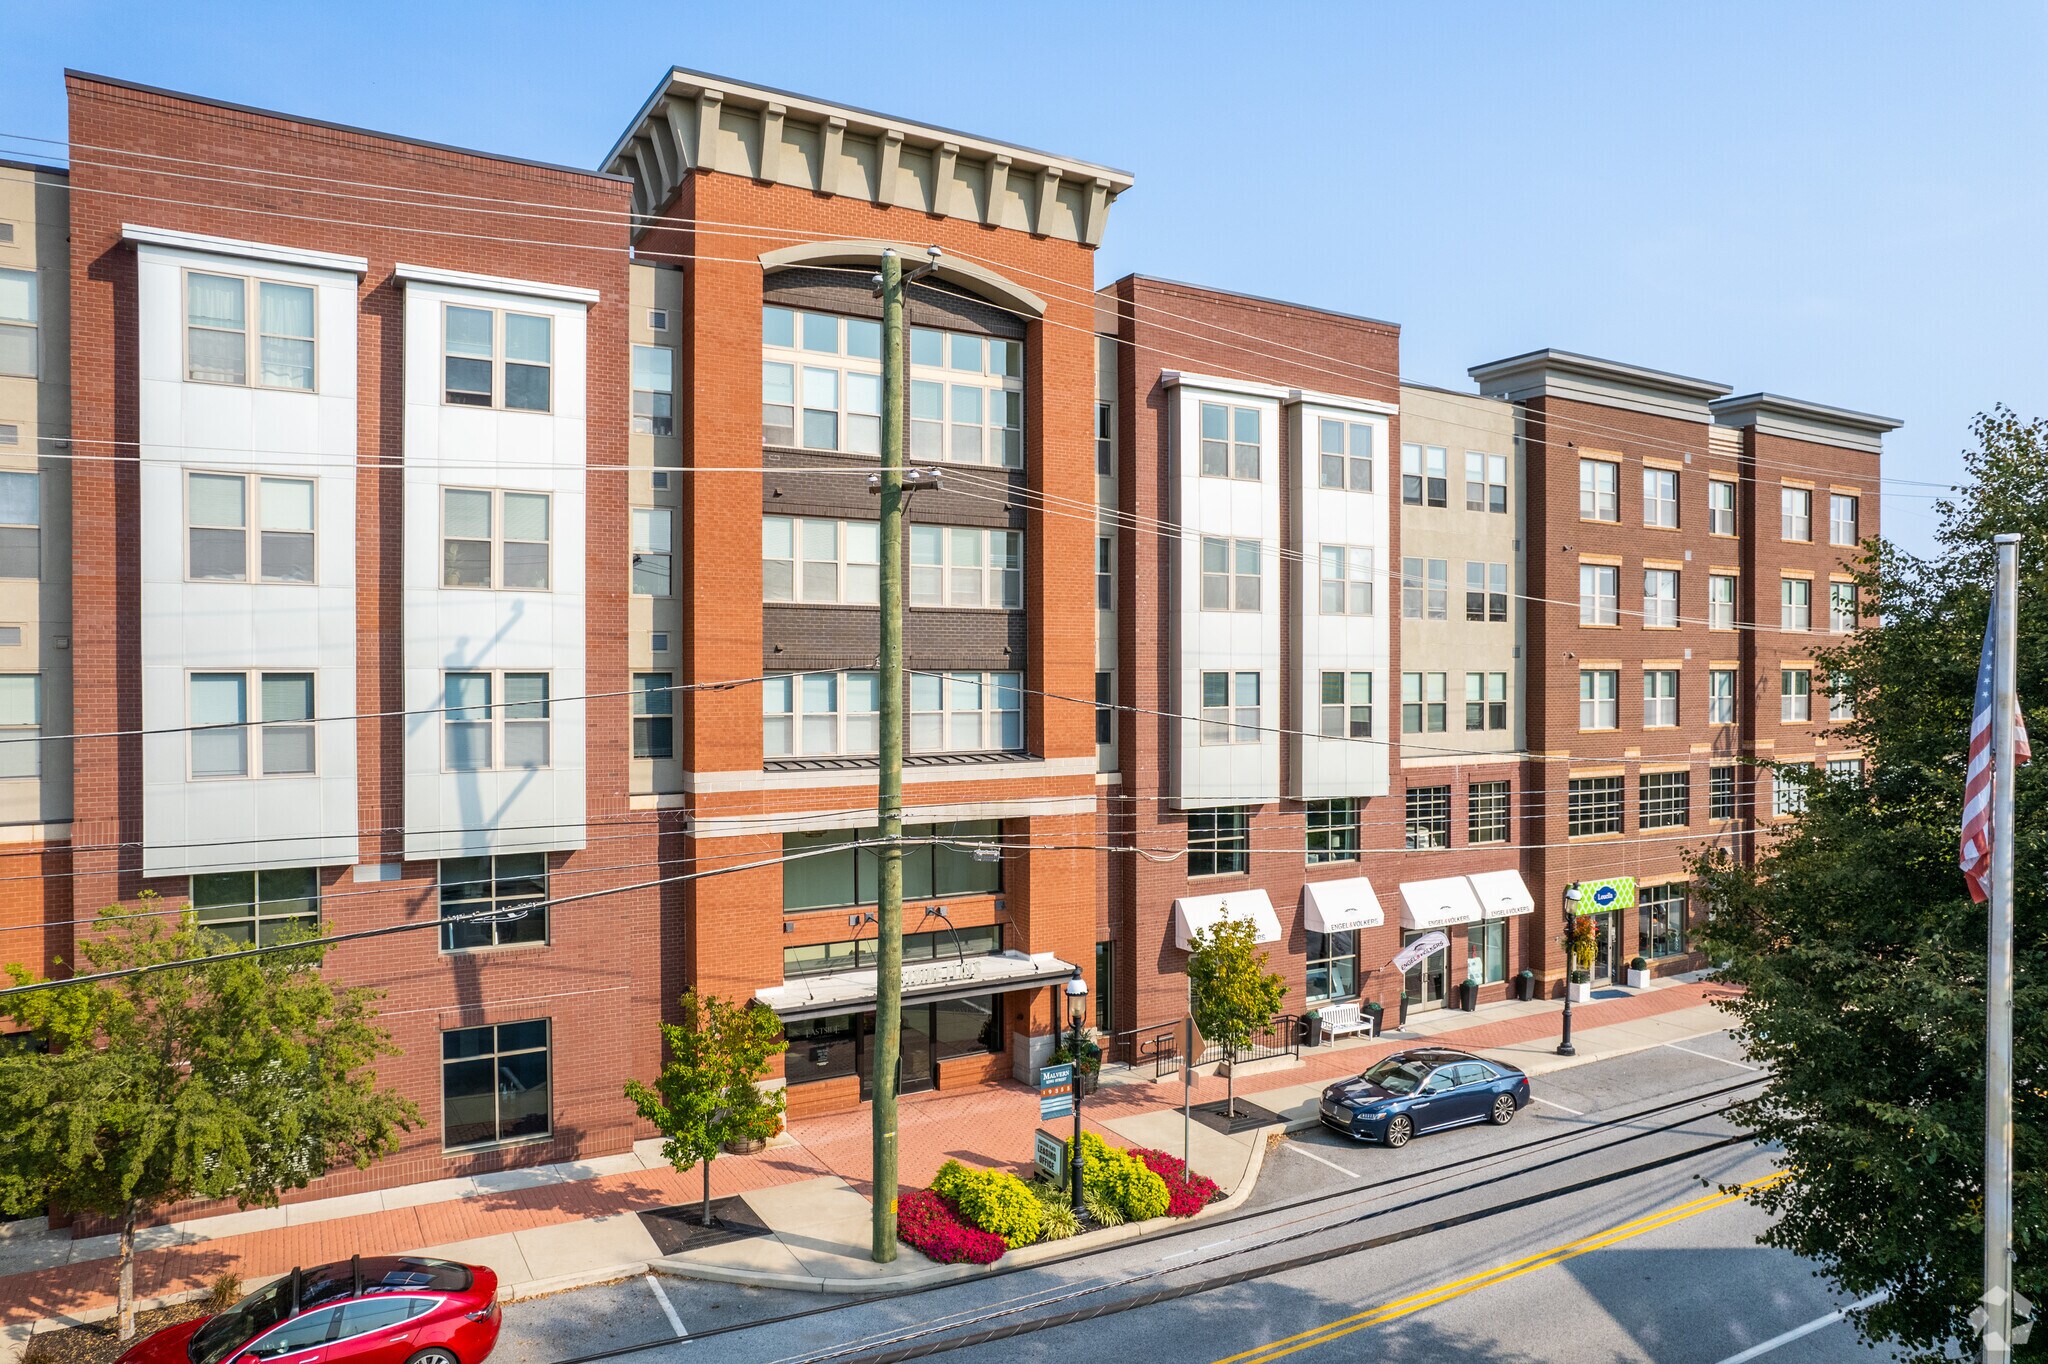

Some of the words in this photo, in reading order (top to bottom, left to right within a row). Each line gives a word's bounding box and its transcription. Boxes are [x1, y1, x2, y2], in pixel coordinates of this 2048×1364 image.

[1043, 1070, 1070, 1080] MALVERN
[1037, 1144, 1057, 1162] LEASING
[1039, 1154, 1055, 1170] OFFICE
